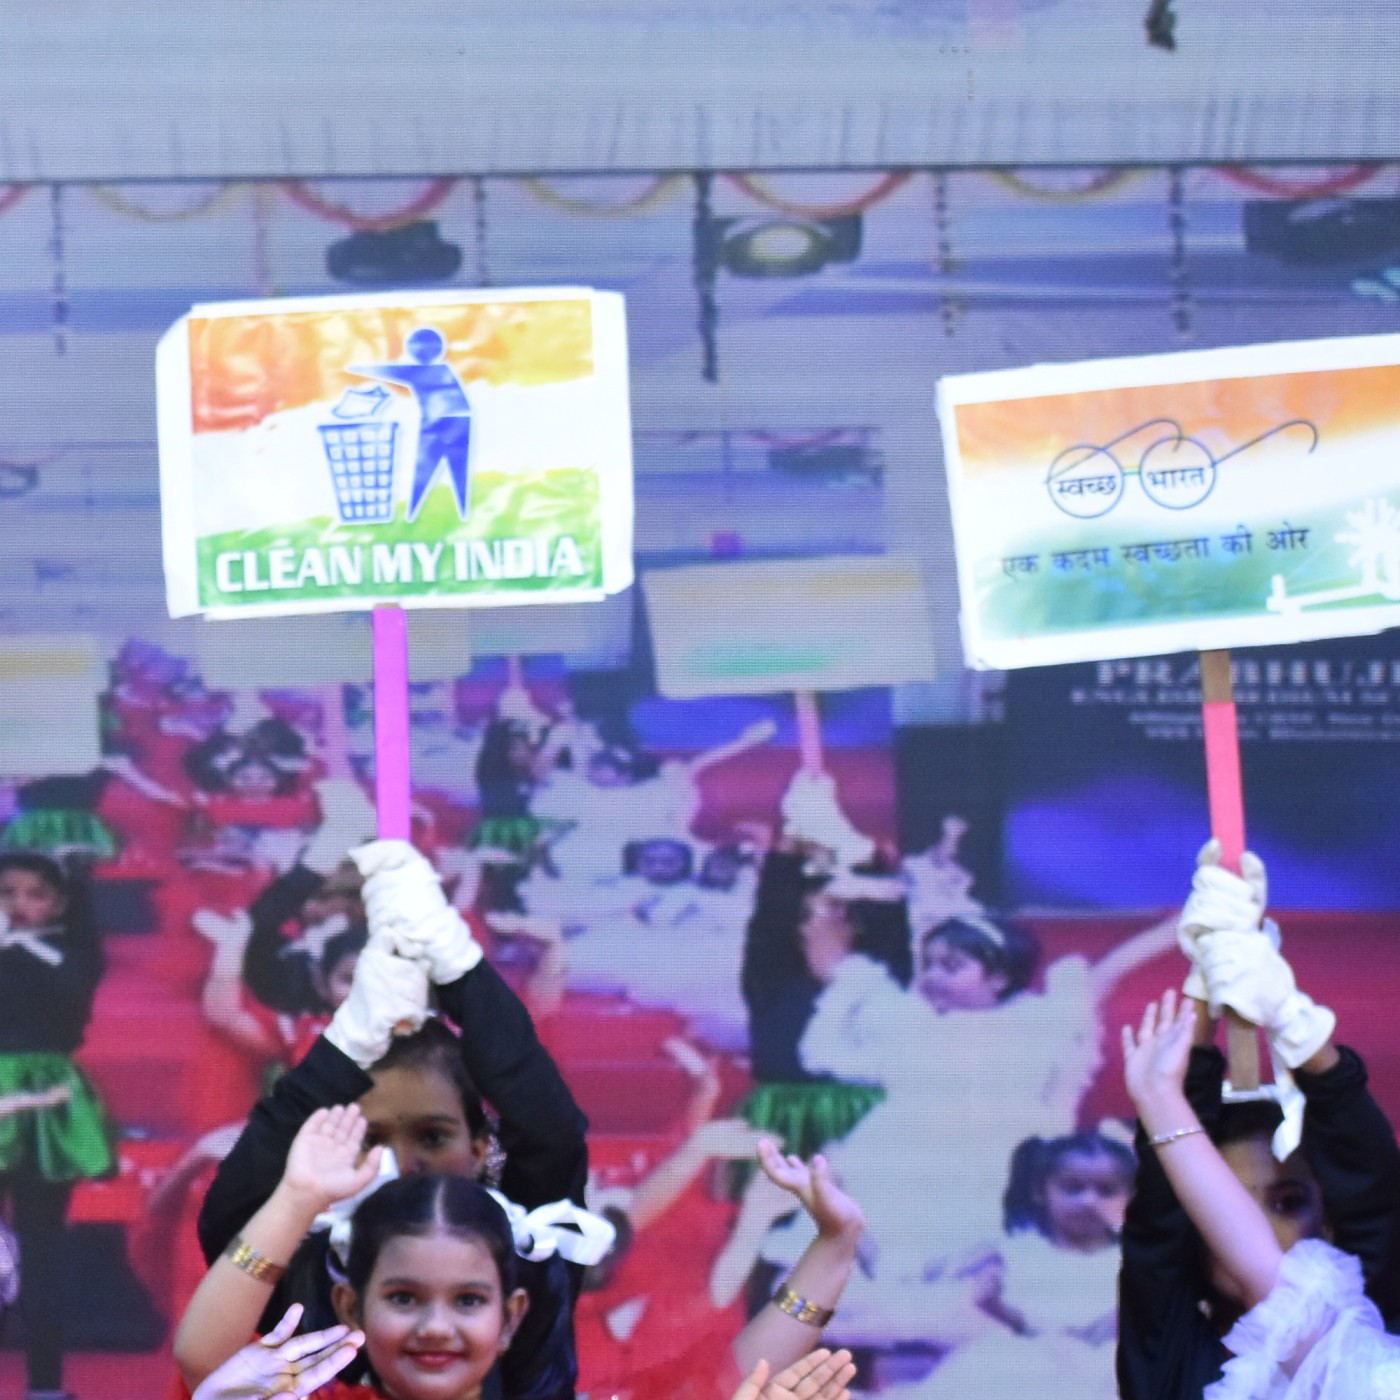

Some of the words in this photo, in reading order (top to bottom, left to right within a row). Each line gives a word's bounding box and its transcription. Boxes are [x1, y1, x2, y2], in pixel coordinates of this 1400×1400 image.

[1057, 473, 1116, 497] स्वच्छ
[1148, 466, 1206, 489] भारत
[215, 544, 364, 592] CLEAN
[373, 540, 444, 584] MY
[453, 535, 586, 580] INDIA
[1002, 553, 1039, 582] एक
[1052, 545, 1109, 573] कदम
[1120, 537, 1209, 566] स्वच्छता
[1220, 524, 1253, 554] की
[1267, 521, 1311, 550] ओर
